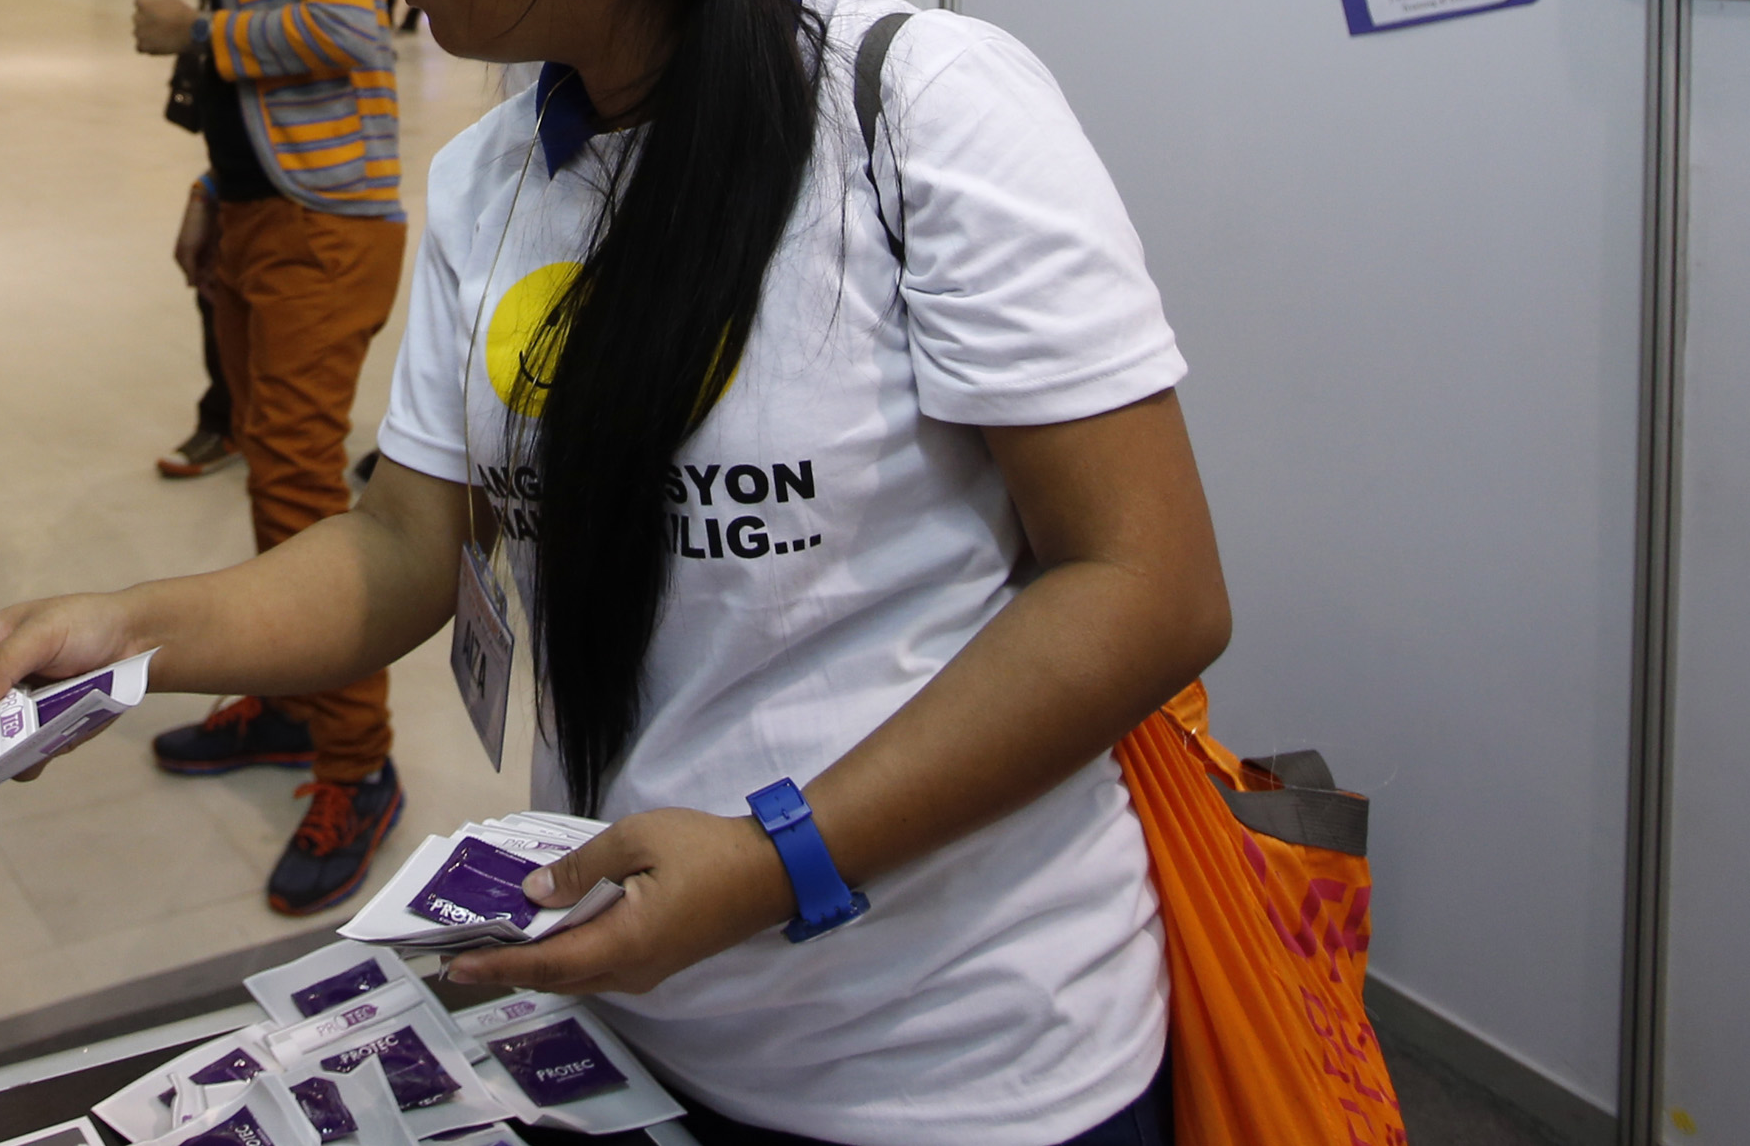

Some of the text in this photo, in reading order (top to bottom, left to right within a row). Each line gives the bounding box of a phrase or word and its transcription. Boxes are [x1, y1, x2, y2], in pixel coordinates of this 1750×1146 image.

[316, 1004, 377, 1037] PROTEC
[340, 1034, 399, 1065] PROTEC
[536, 1058, 595, 1082] PROTEC
[235, 1123, 262, 1146] OTEC
